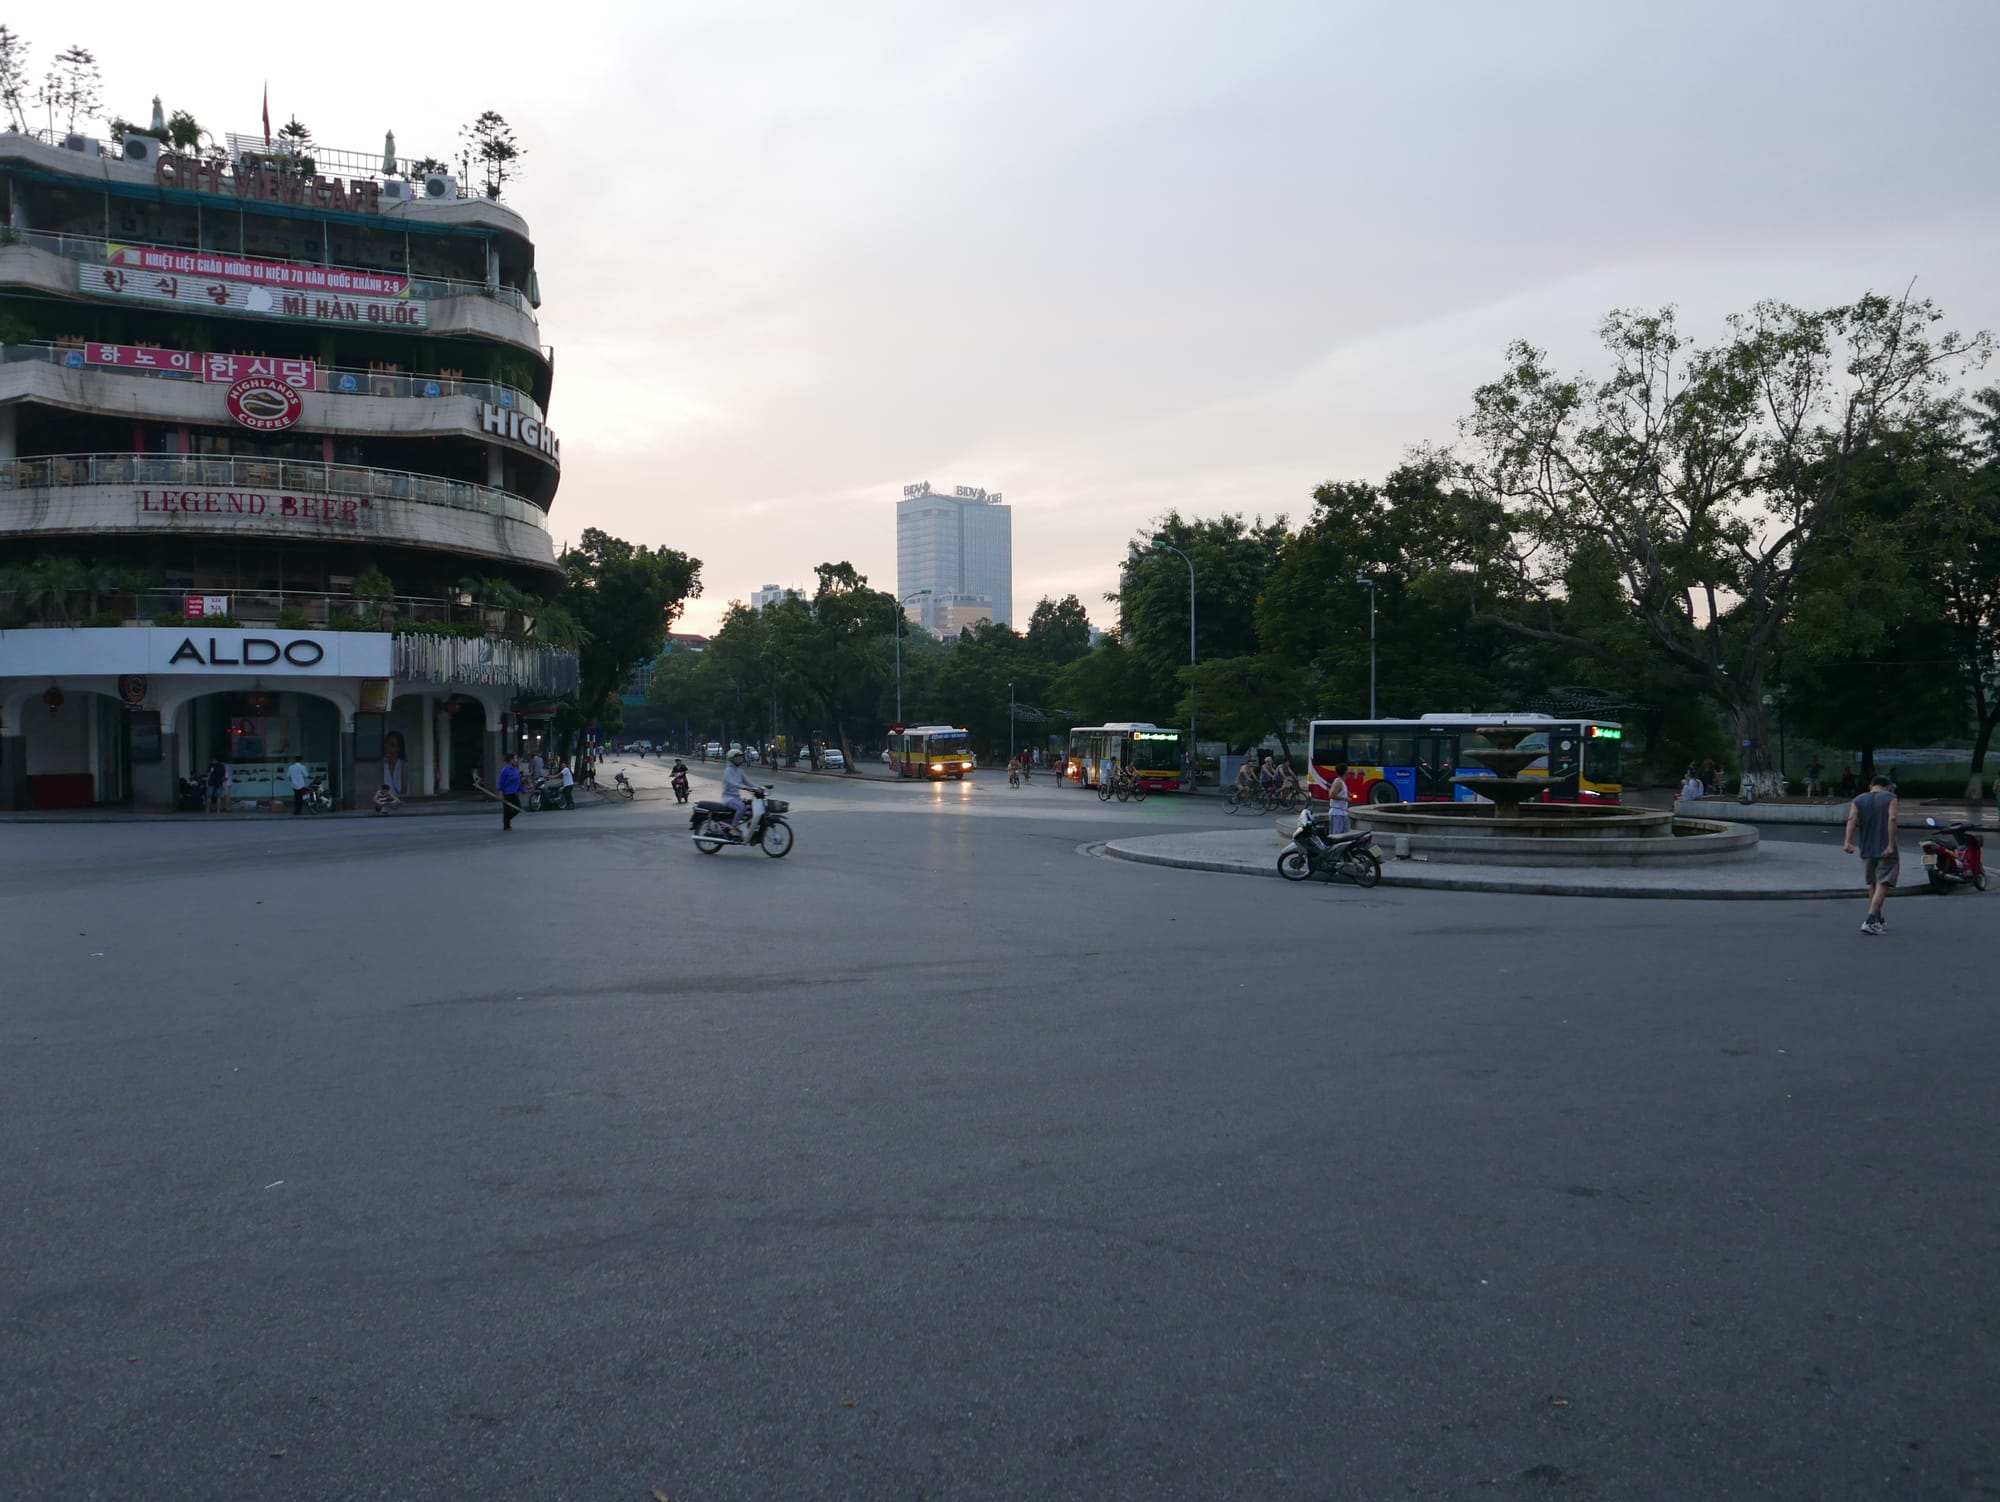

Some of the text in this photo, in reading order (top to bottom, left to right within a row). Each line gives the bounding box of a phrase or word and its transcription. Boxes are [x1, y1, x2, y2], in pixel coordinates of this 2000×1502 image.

[156, 153, 225, 194] CITY
[231, 164, 305, 206] VIEW
[197, 258, 222, 274] CHÀO
[291, 269, 303, 283] 70
[316, 295, 359, 320] HÀN
[367, 301, 420, 325] QUỐC
[230, 379, 299, 405] HIGHLANDS
[238, 412, 291, 429] COFFEE
[903, 482, 923, 496] BIDV
[956, 485, 978, 498] BIDV
[142, 490, 359, 522] LEGEND BEER
[168, 637, 325, 667] ALDO
